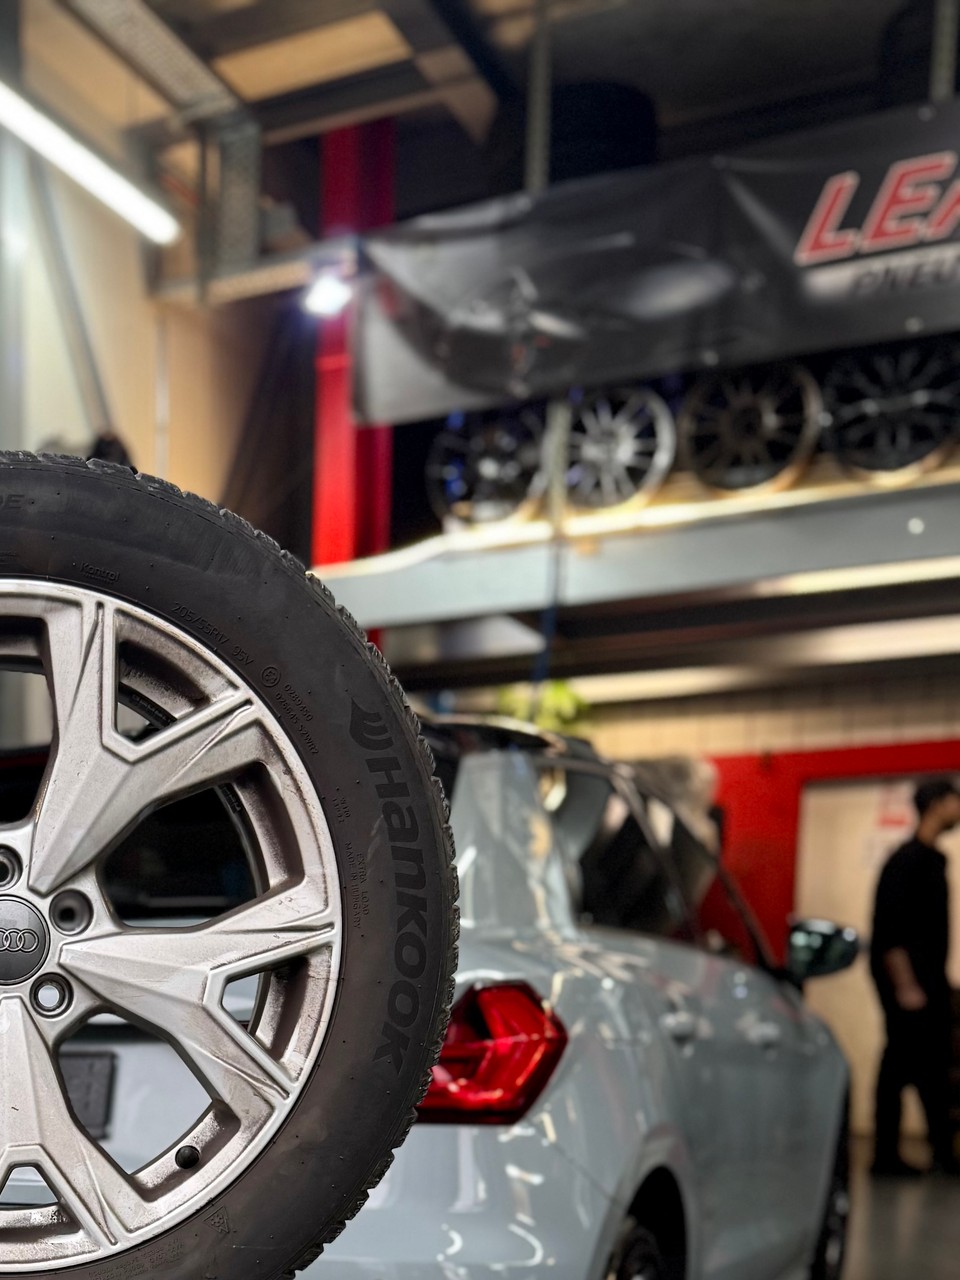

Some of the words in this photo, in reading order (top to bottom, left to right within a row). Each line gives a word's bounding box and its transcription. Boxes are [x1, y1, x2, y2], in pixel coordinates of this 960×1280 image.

[170, 599, 230, 647] 205/55R17
[343, 840, 356, 869] MADE
[355, 852, 367, 884] EXTRA
[349, 871, 358, 881] IN
[350, 883, 360, 929] HUNGARY
[360, 890, 369, 915] LOAD
[364, 755, 428, 1076] Hankook
